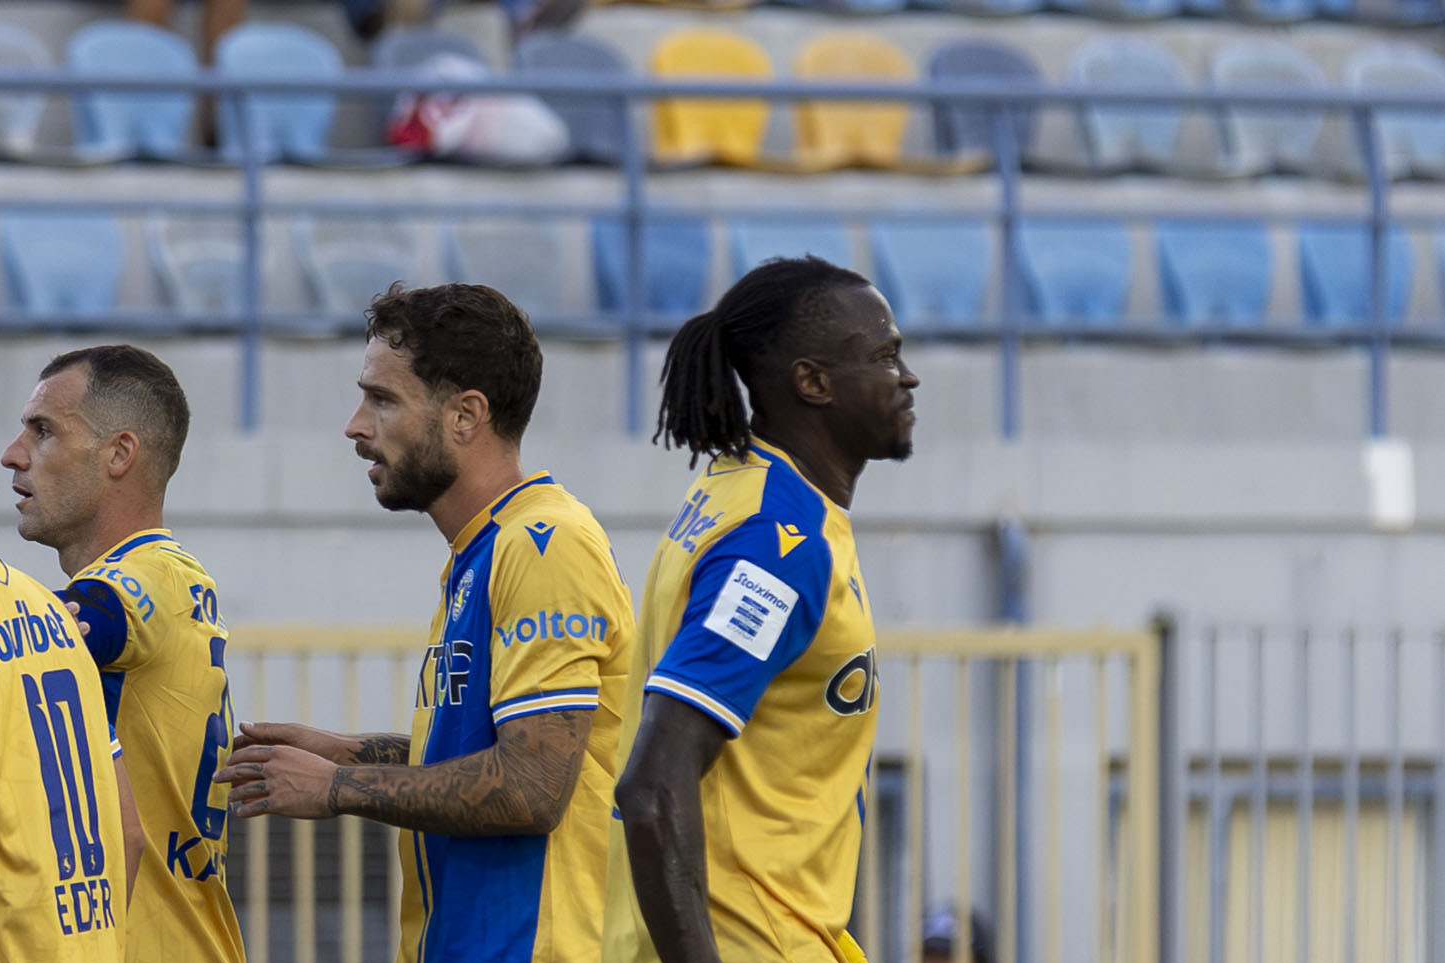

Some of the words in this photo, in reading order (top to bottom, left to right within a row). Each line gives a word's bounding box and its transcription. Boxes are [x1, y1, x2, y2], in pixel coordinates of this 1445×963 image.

[733, 572, 789, 615] Stoiximan
[495, 610, 608, 649] volton
[21, 668, 105, 881] 10
[54, 878, 116, 935] EDER
